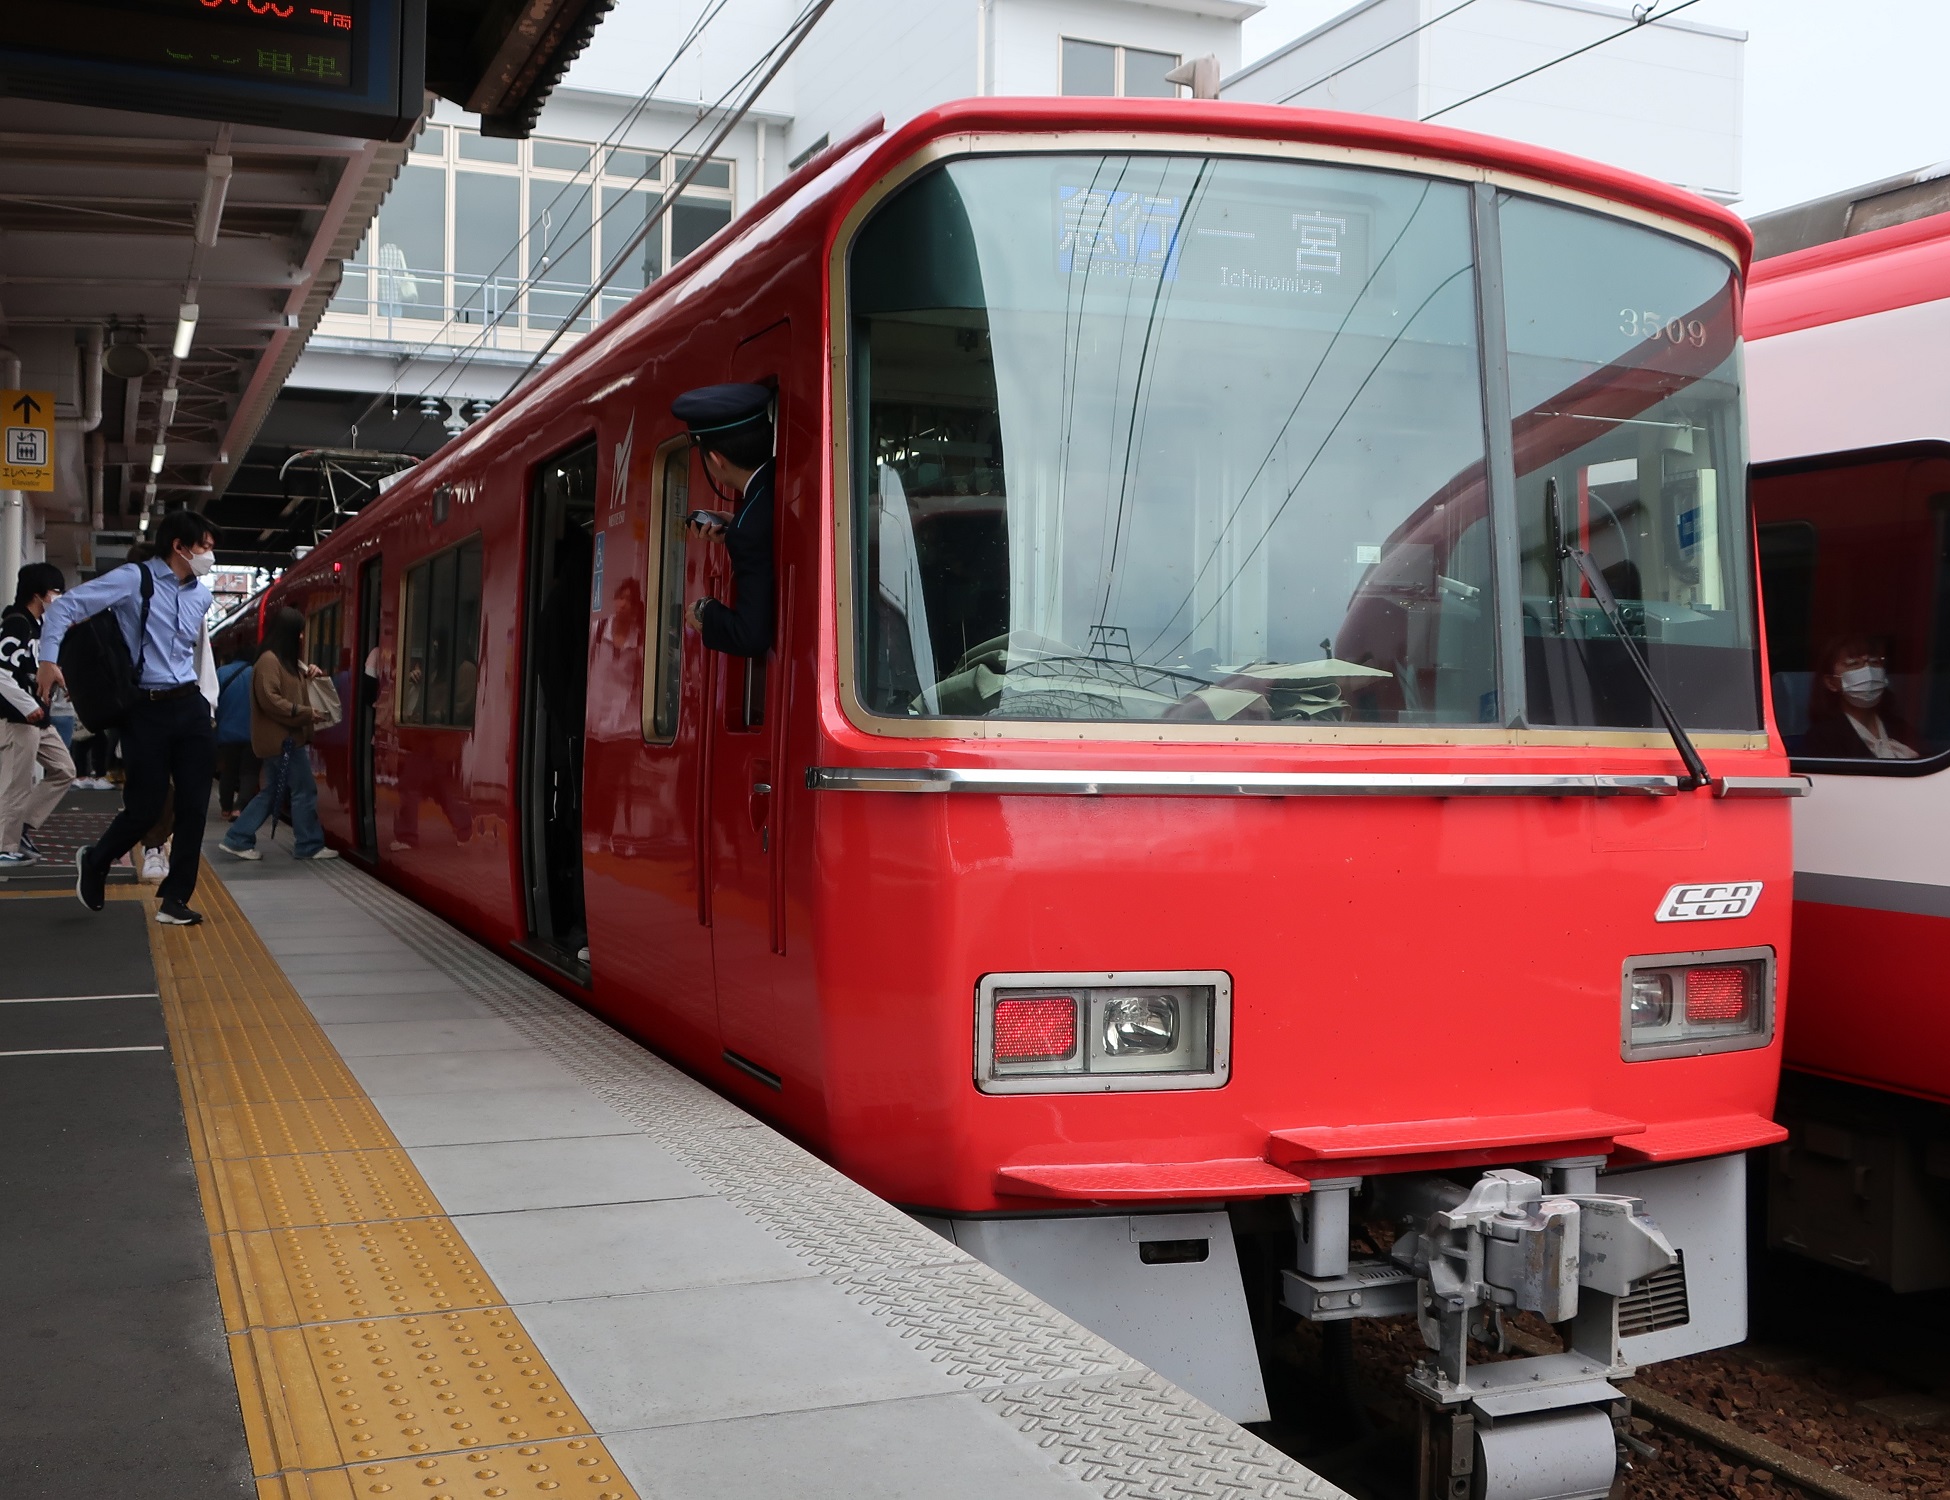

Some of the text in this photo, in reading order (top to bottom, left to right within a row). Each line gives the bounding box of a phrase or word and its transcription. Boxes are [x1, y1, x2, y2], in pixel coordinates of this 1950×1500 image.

[1060, 187, 1347, 276] 急行 一宮
[1074, 253, 1324, 295] Express Ichinomiya
[1619, 308, 1707, 348] 3509
[2, 467, 50, 479] エレベーター
